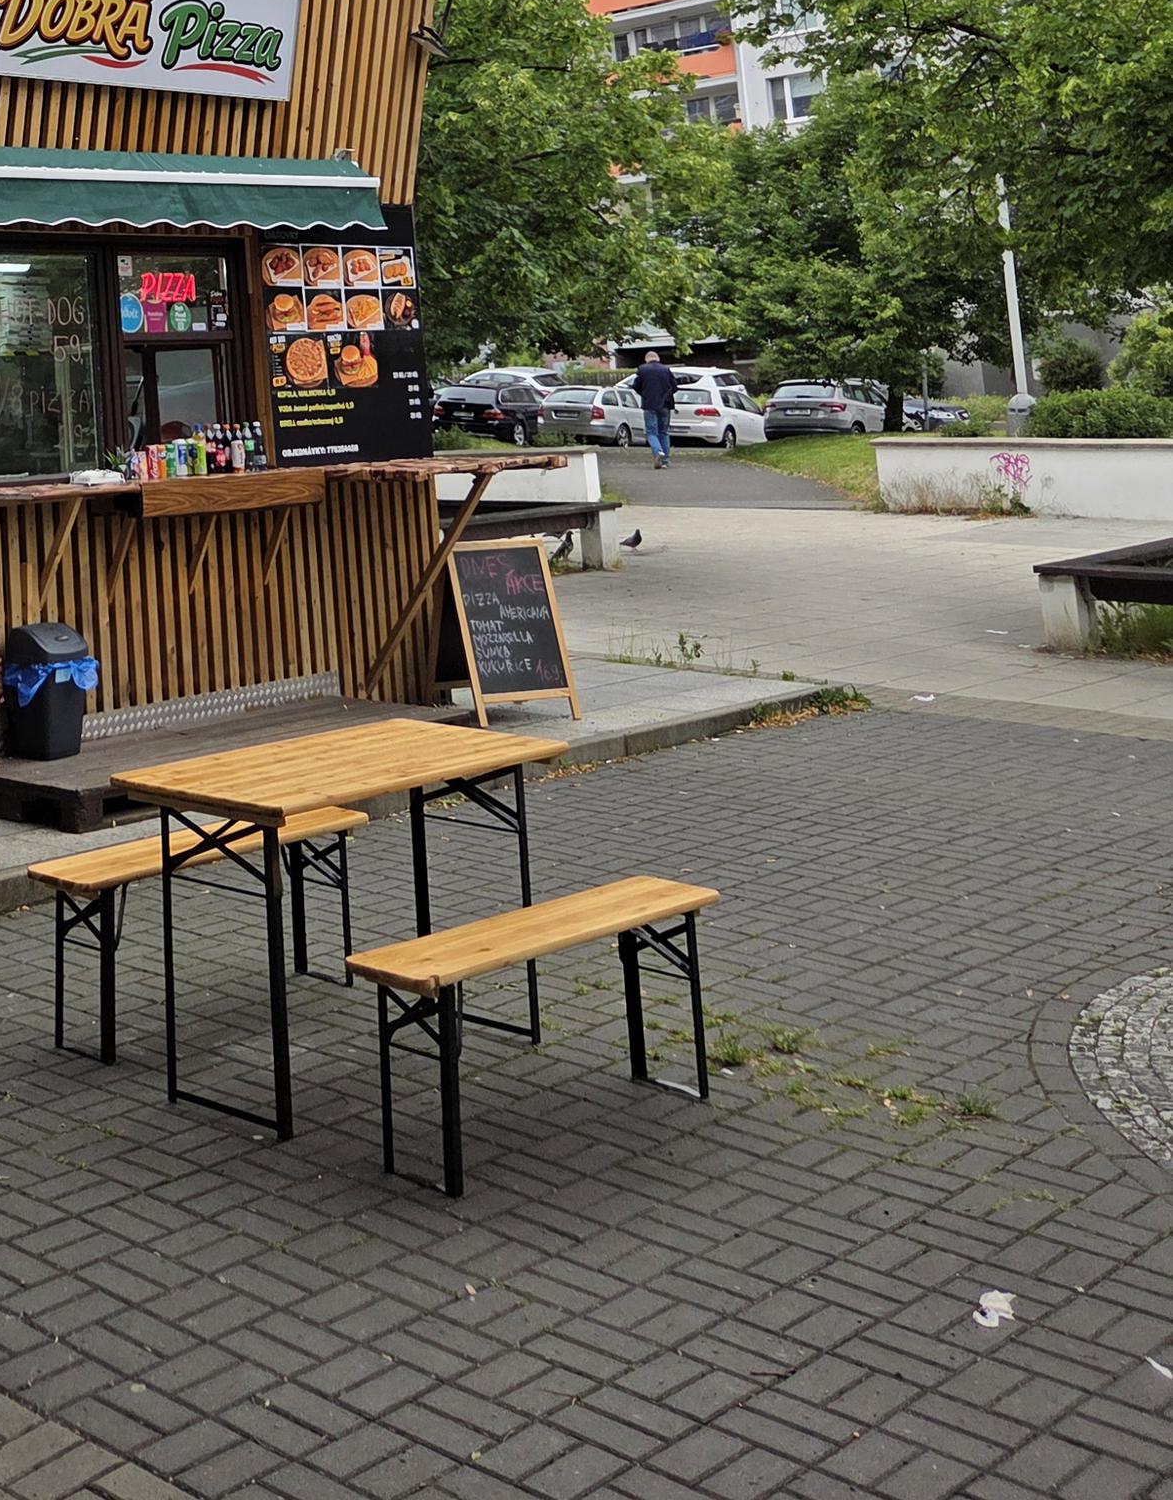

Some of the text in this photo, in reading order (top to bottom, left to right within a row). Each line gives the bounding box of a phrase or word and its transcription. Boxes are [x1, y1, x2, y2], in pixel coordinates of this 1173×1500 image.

[140, 272, 196, 301] PIZZA
[47, 296, 85, 325] DOG
[463, 591, 500, 607] PIZZA
[499, 605, 550, 621] AMERICANA
[469, 620, 504, 632] TOMAT
[473, 631, 534, 648] MOZZARELLA
